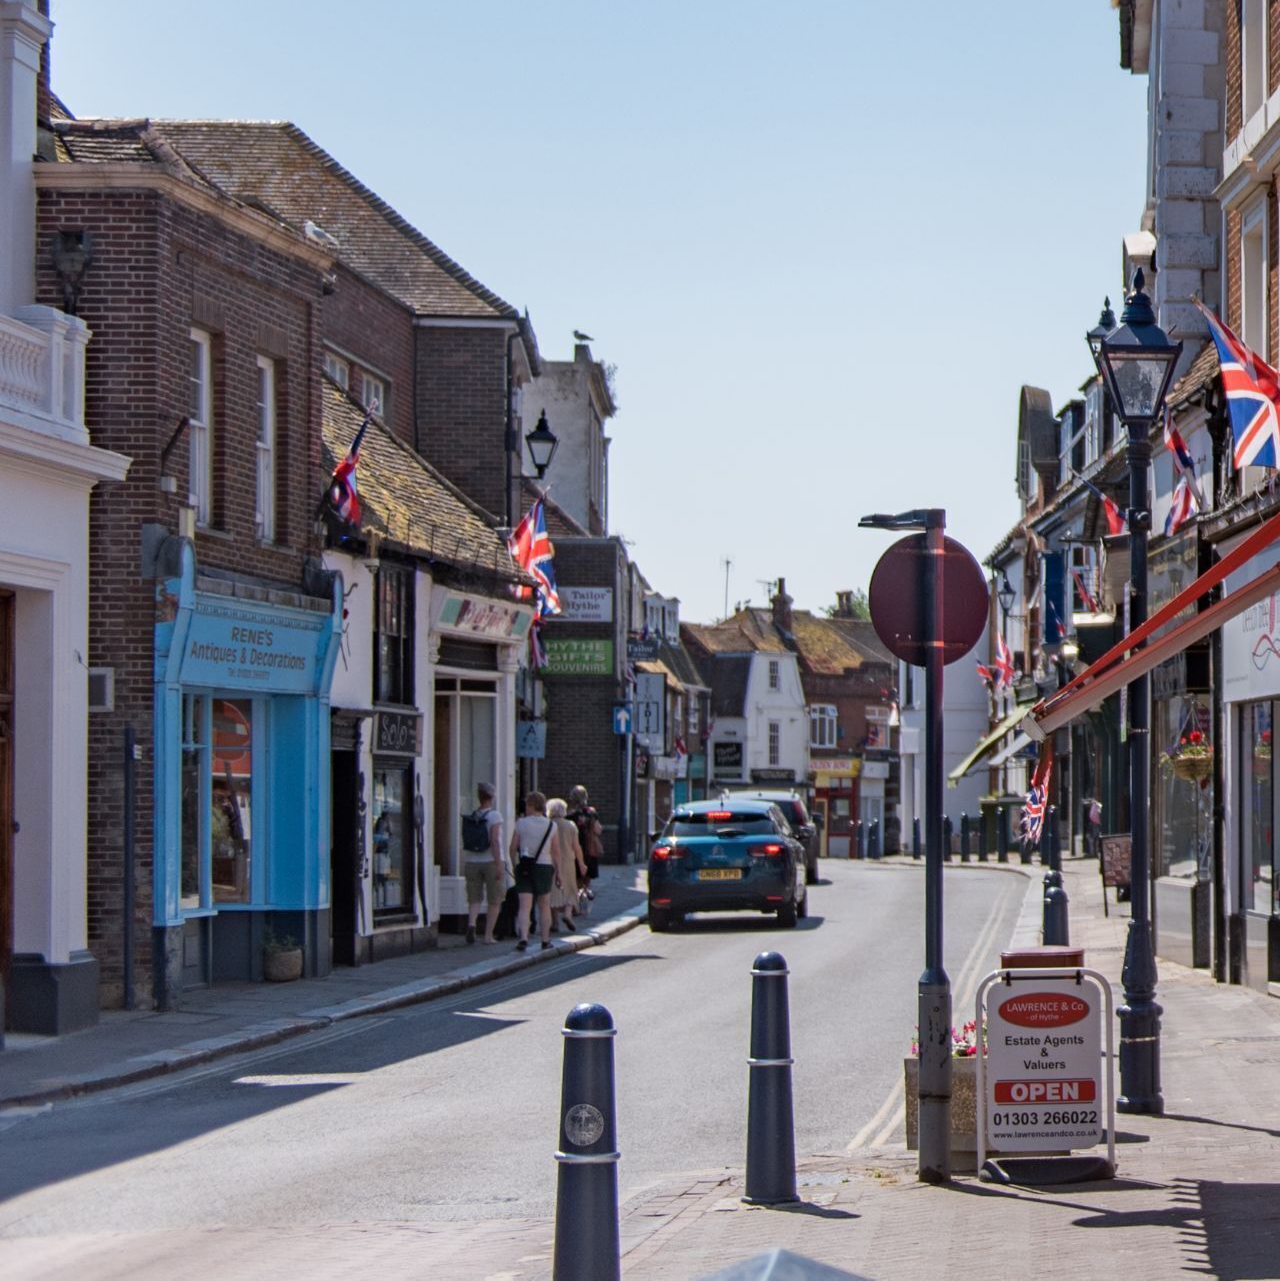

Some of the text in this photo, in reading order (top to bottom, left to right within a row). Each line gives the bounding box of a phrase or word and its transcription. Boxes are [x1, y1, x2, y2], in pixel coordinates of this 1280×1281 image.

[230, 627, 274, 647] RENE'S
[546, 641, 604, 651] HYTHE
[191, 641, 306, 671] Antiques & Decorations
[547, 653, 605, 661] GIFTS
[1007, 1002, 1084, 1013] LAWRENCE & Co
[1039, 1013, 1059, 1022] Hythe
[1005, 1035, 1084, 1047] Estate Agents
[1040, 1047, 1049, 1057] &
[1024, 1060, 1066, 1070] Valuers
[1011, 1082, 1079, 1102] OPEN
[994, 1110, 1097, 1126] 01303 266022
[994, 1130, 1098, 1140] www.lawrenceandco.co.uk
